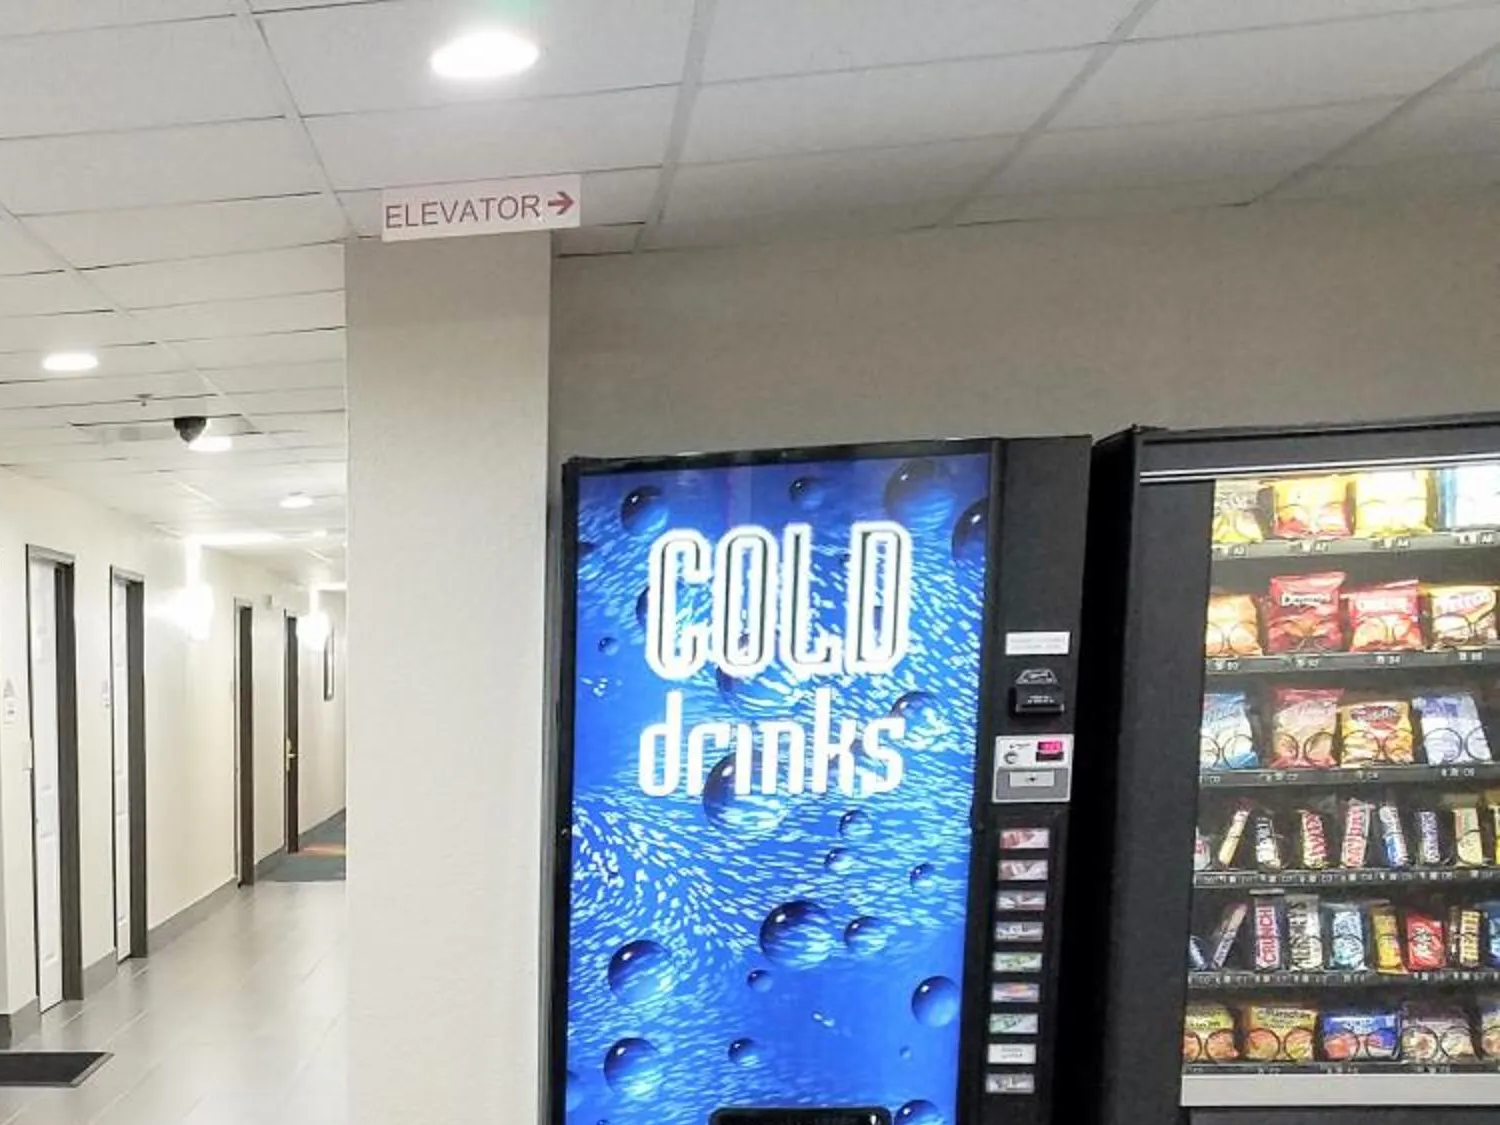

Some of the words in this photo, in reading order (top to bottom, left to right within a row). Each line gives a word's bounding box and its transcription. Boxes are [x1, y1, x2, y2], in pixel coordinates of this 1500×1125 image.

[385, 194, 541, 229] ELEVATOR
[646, 521, 913, 680] COLD
[638, 688, 906, 797] drinks
[1258, 908, 1277, 962] CRUNCH
